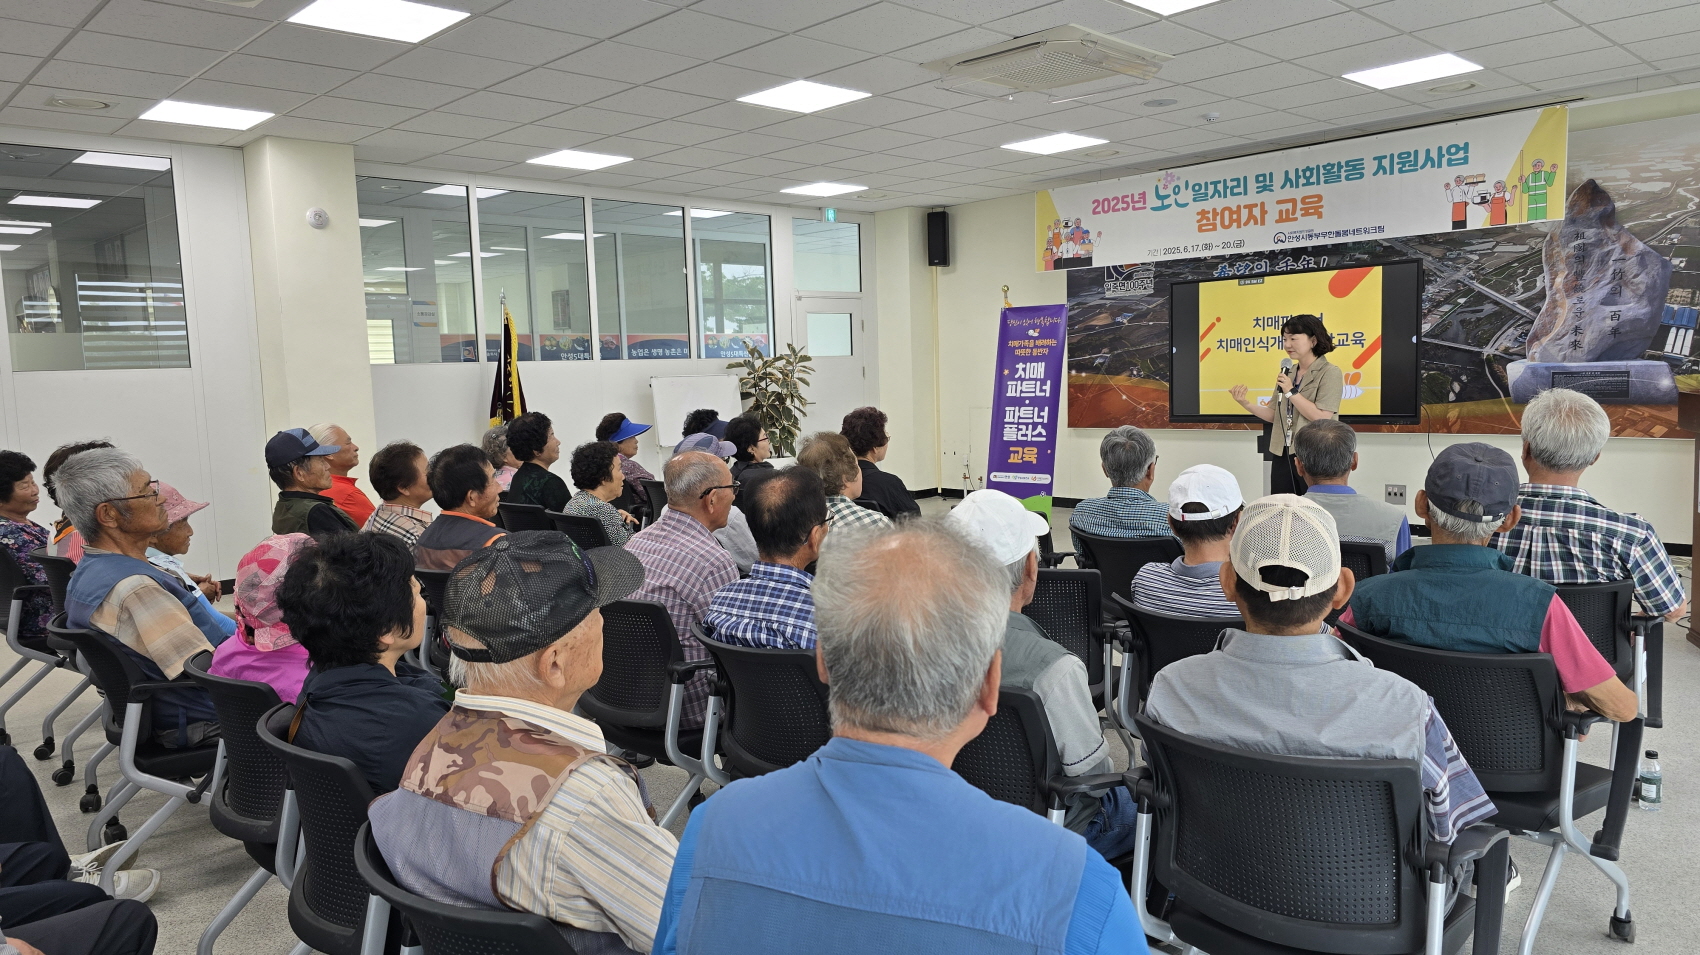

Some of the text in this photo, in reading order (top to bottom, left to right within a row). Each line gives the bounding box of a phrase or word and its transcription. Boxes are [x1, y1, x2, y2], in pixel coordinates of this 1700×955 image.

[1091, 191, 1147, 215] 2025년
[1255, 172, 1274, 194] 및
[1280, 157, 1365, 190] 사회활동
[1372, 142, 1470, 177] 지원사업
[1196, 193, 1324, 233] 참여자 교육
[1015, 362, 1045, 380] 치매
[1006, 380, 1051, 398] 파트너
[1004, 406, 1049, 424] 파트너
[1003, 424, 1047, 442] 플러스
[1008, 447, 1038, 464] 교육
